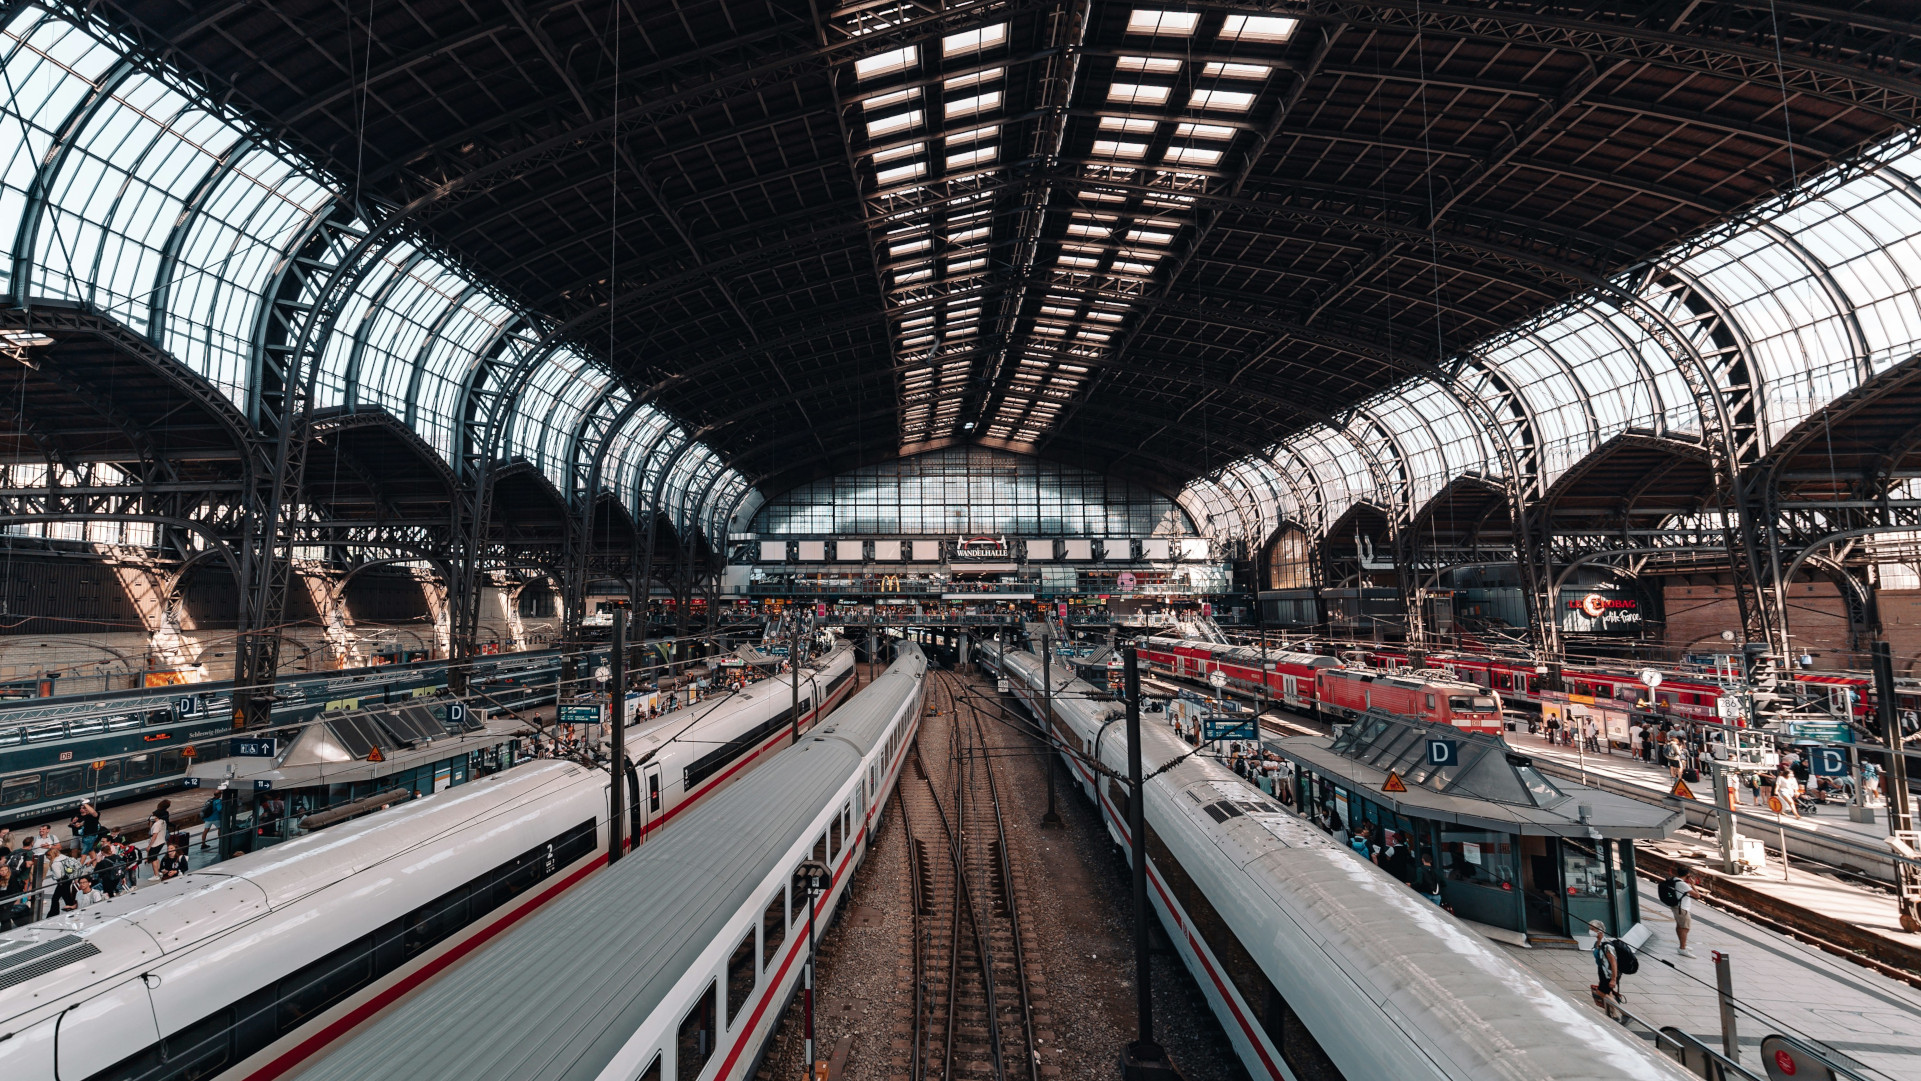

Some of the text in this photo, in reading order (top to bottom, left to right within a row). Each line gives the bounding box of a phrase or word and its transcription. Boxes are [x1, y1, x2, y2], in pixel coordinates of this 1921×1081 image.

[957, 549, 1008, 557] WANDELHALLE
[1568, 600, 1583, 608] LE
[180, 698, 190, 713] D
[451, 704, 462, 721] D
[1432, 741, 1449, 762] D
[1822, 750, 1842, 772] D
[547, 843, 554, 859] 2
